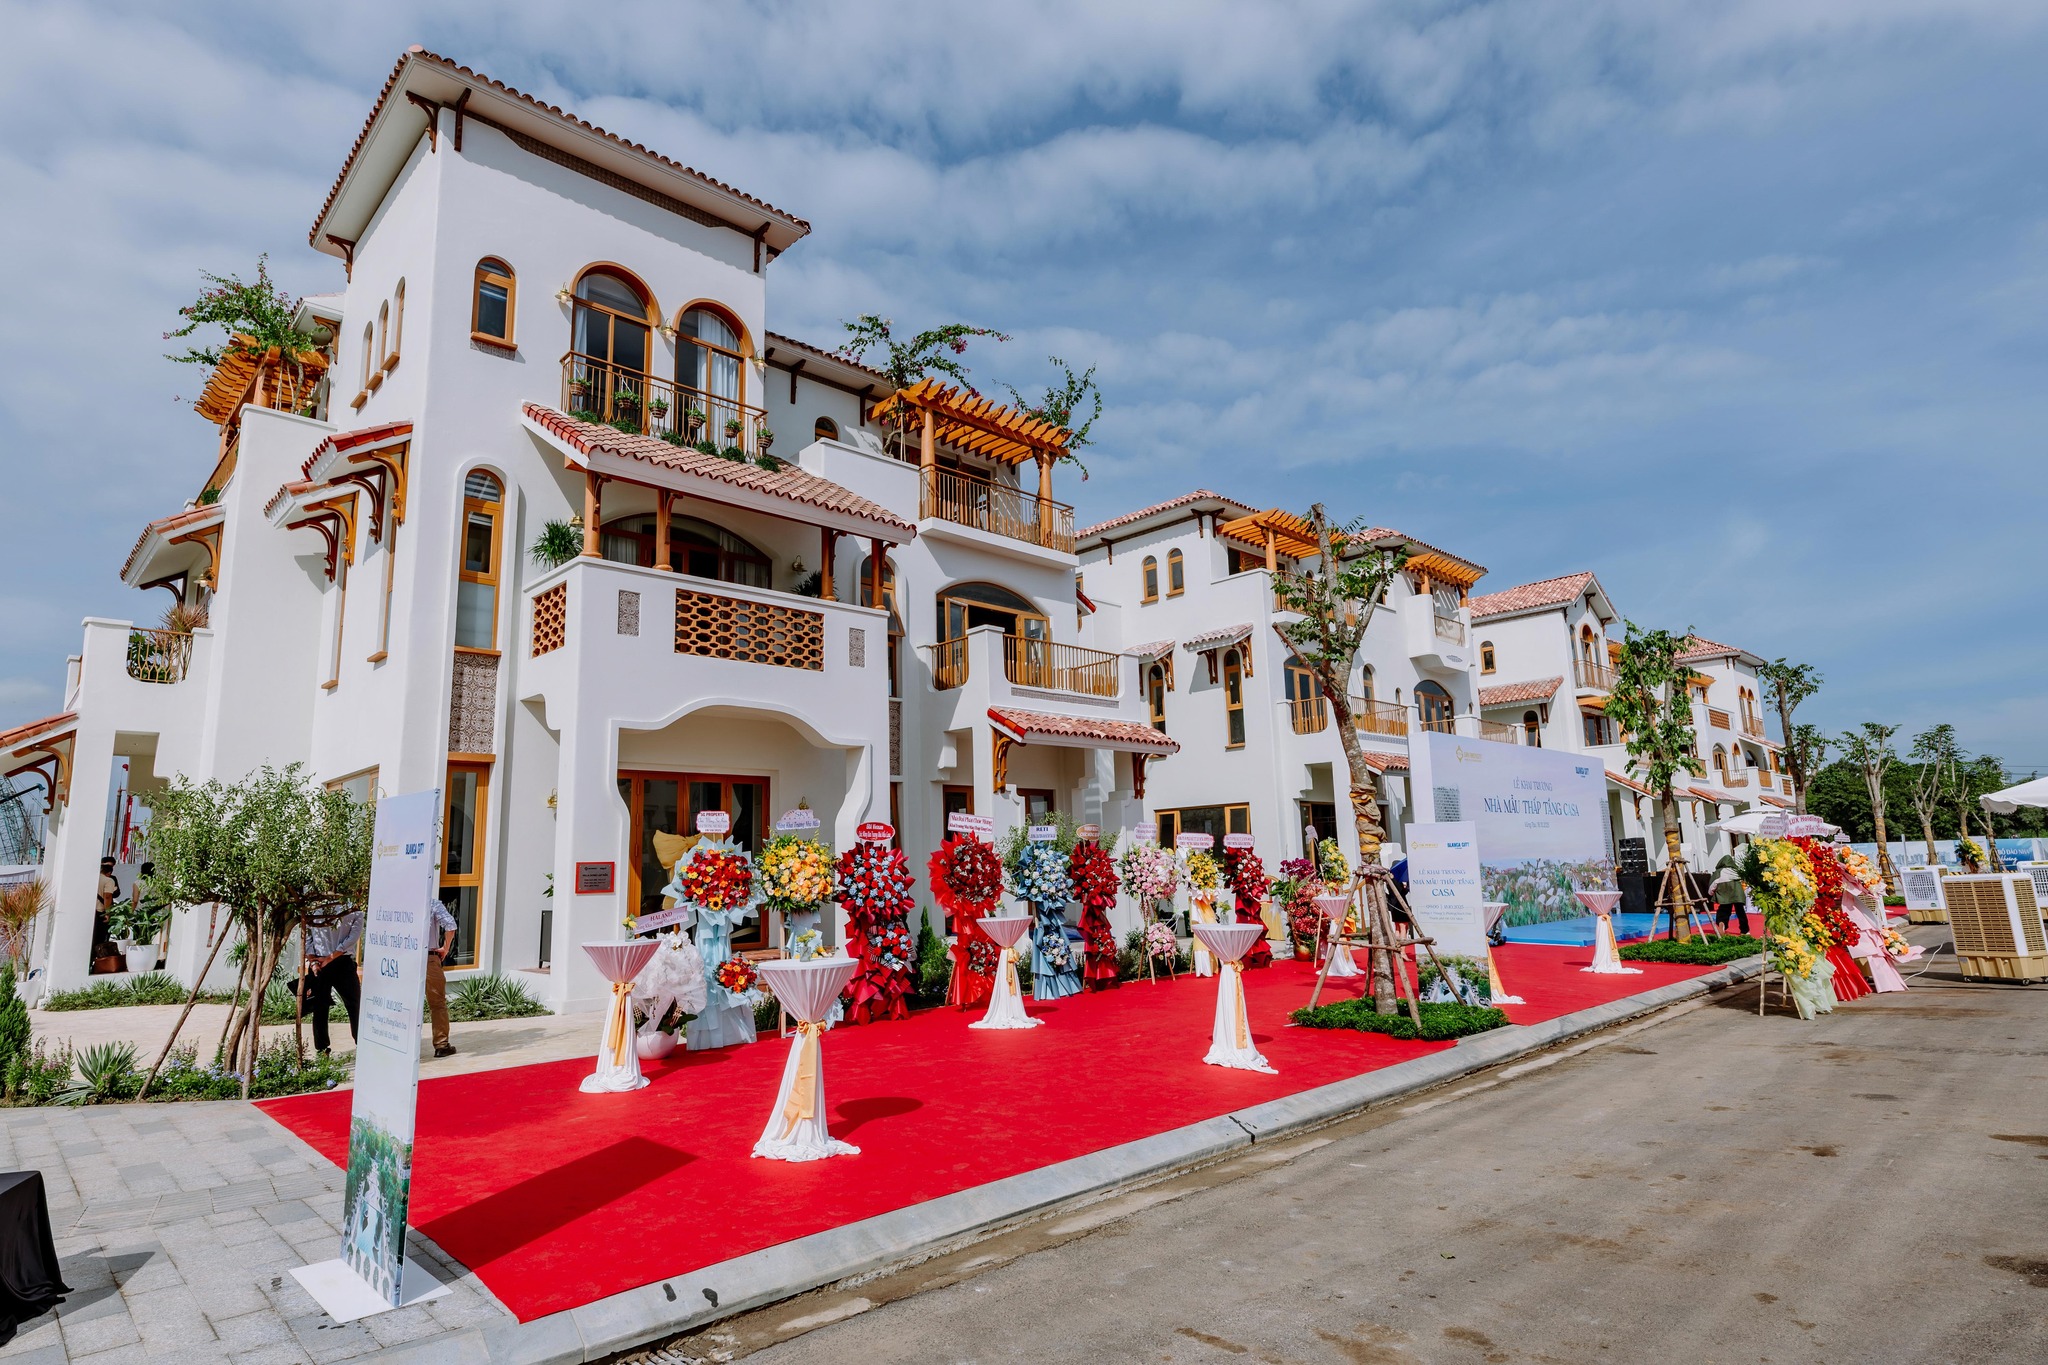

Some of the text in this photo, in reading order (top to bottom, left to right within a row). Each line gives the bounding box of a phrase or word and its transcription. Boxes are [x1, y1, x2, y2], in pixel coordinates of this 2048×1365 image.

[1563, 802, 1580, 816] CASA
[1789, 817, 1800, 825] LUX
[1800, 816, 1823, 824] Holdings
[405, 842, 425, 855] BLANCA CITY
[1431, 888, 1455, 897] CASA
[650, 911, 673, 921] HALAND
[380, 957, 399, 979] CASA
